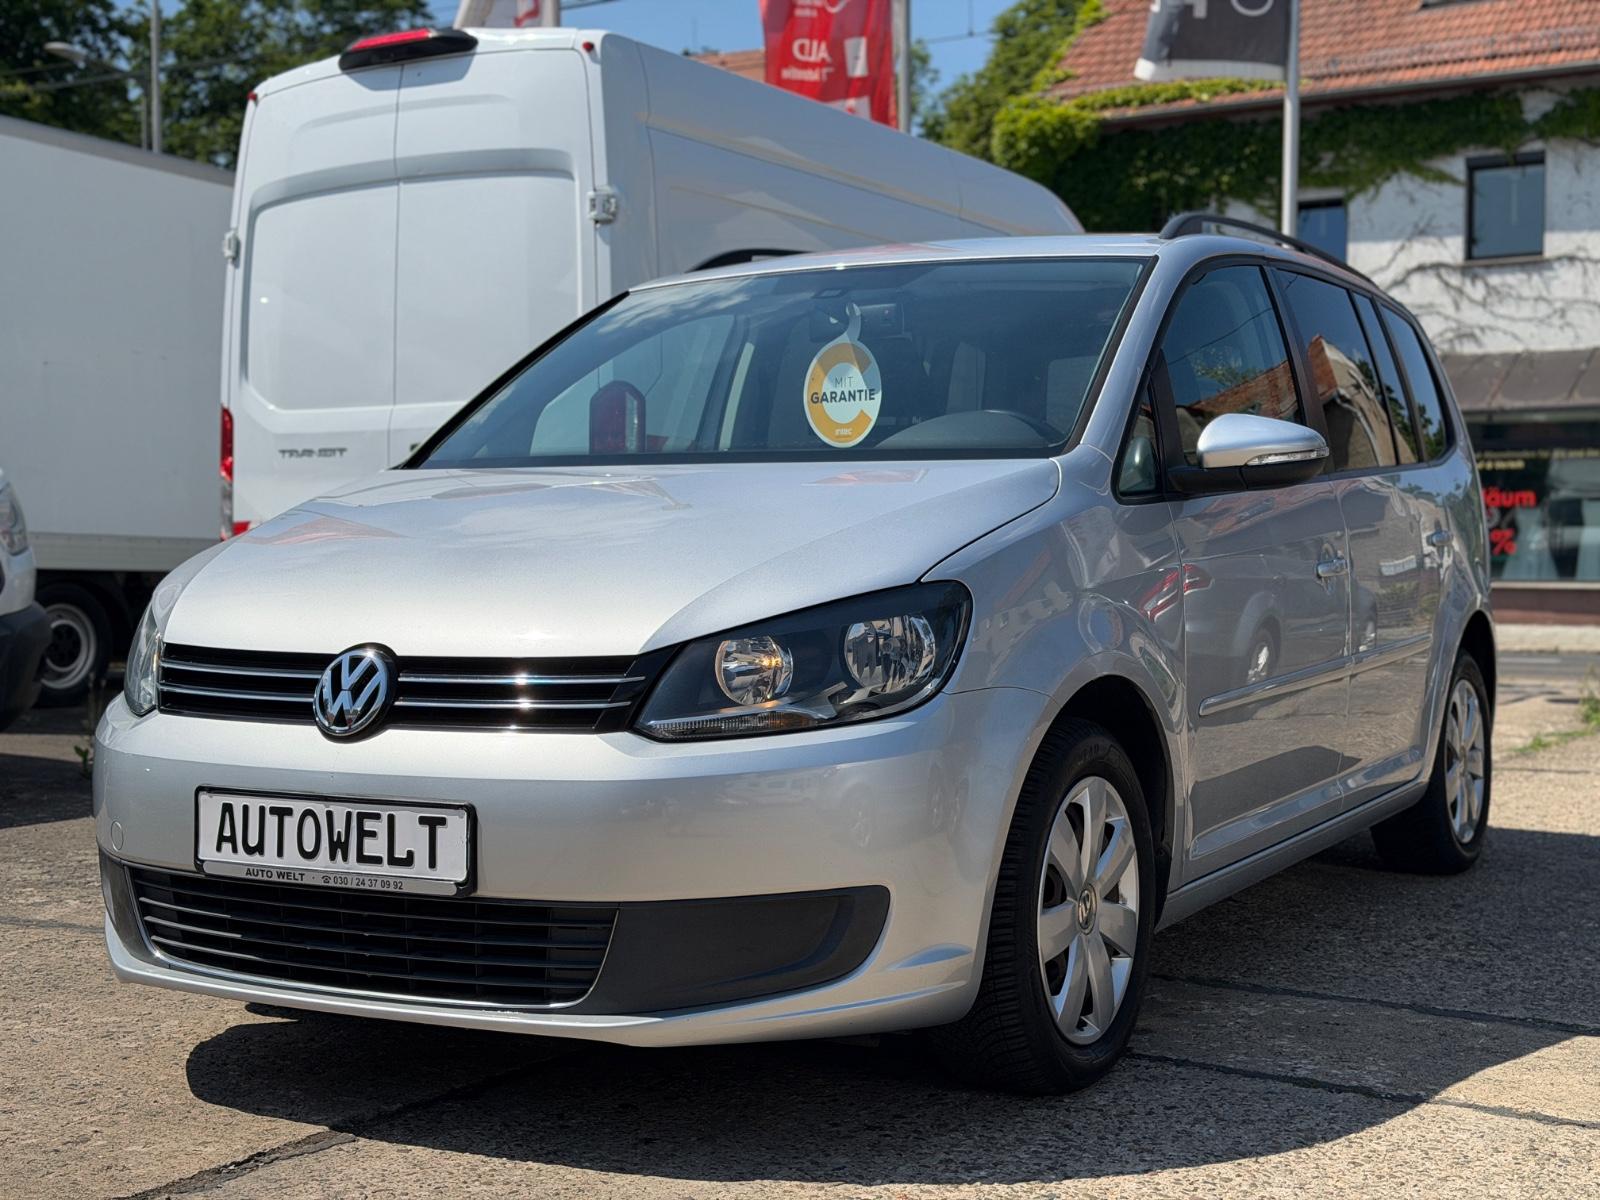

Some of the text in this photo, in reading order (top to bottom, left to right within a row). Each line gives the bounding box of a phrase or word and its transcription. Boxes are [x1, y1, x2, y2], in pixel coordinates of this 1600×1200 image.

[834, 376, 854, 388] MIT
[810, 388, 876, 405] GARANTIE
[1483, 486, 1537, 508] äum
[214, 801, 448, 871] AUTOWELT
[245, 867, 274, 879] AUTO
[275, 871, 306, 882] WELT
[333, 875, 349, 886] 030
[355, 877, 366, 887] 24
[367, 878, 378, 888] 37
[380, 879, 391, 889] 09
[392, 880, 404, 890] 92
